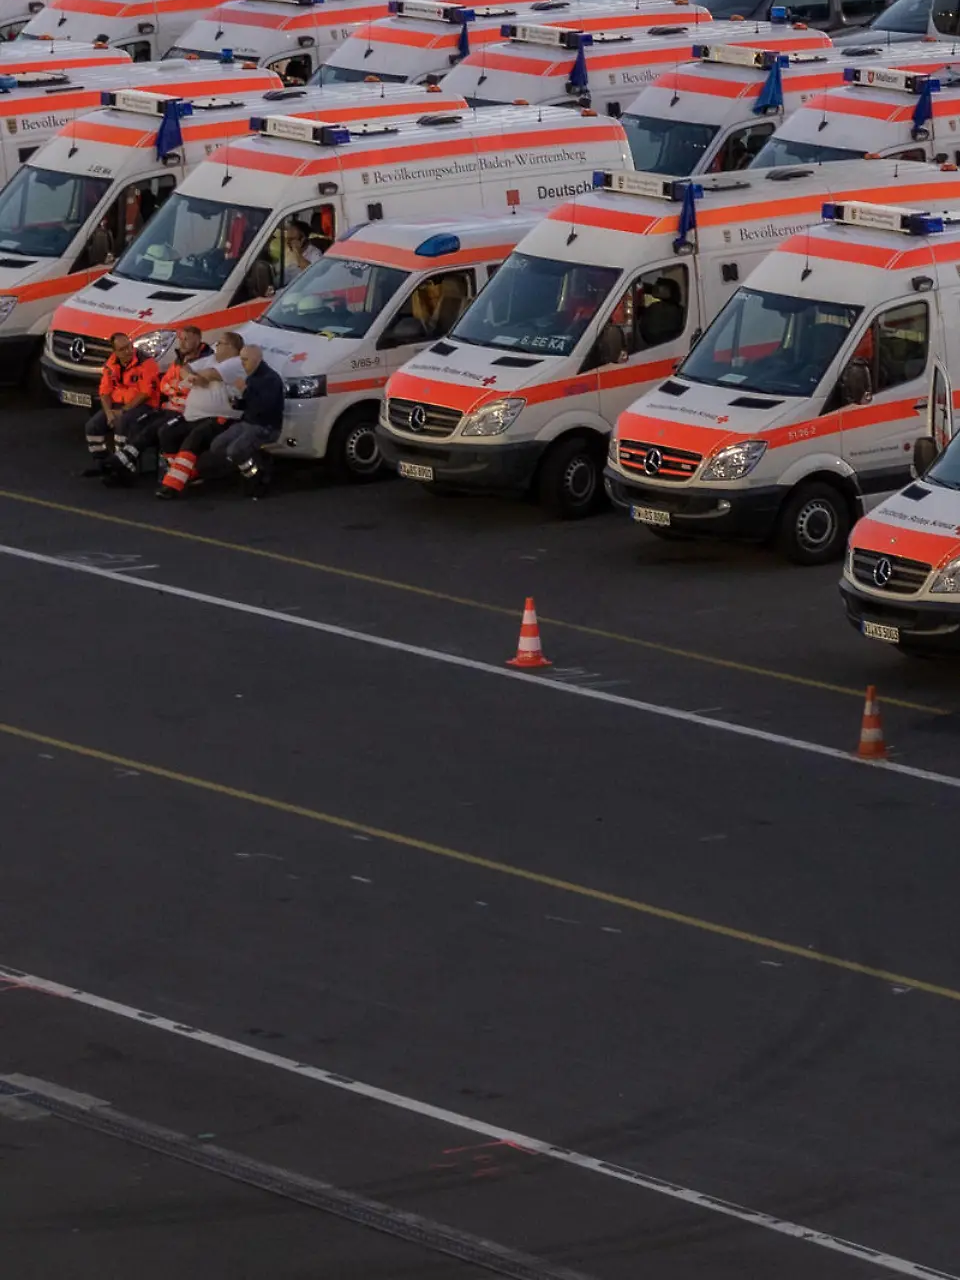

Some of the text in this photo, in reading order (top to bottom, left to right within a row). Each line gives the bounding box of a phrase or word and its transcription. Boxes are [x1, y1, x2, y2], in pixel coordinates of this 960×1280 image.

[374, 149, 587, 184] Bevölkerungsschutz Baden-Württemberg
[548, 337, 565, 350] KA
